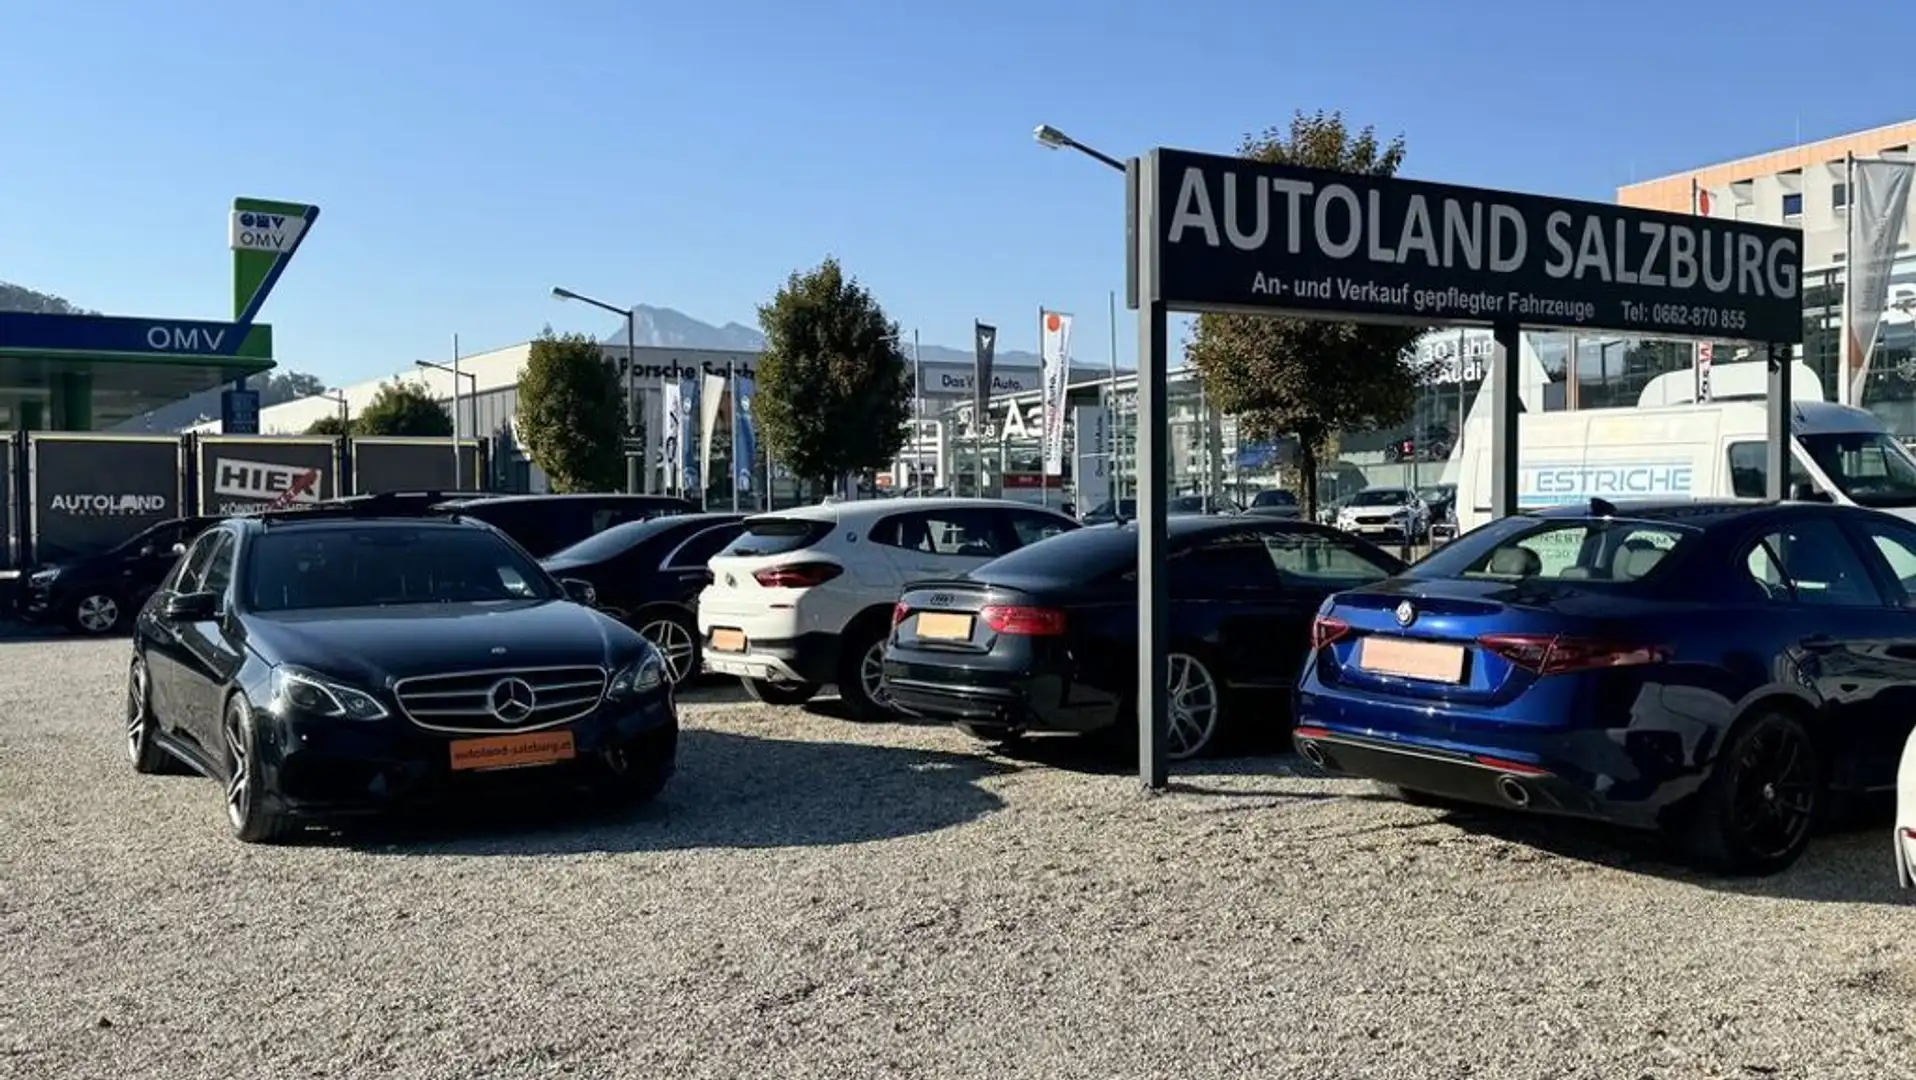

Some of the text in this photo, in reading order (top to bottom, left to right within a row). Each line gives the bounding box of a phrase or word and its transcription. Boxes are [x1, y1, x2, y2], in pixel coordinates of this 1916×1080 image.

[240, 231, 285, 249] OMV
[1168, 167, 1527, 274] AUTOLAND
[1545, 210, 1797, 298] SALZBURG
[1252, 271, 1747, 330] An- und Verkauf gepflegter Fahrzeuge Tel: 0662-870 855
[147, 326, 225, 351] OMV
[618, 357, 696, 378] Porsche
[1536, 468, 1692, 492] ESTRICHE
[50, 494, 165, 510] AUTOLAND
